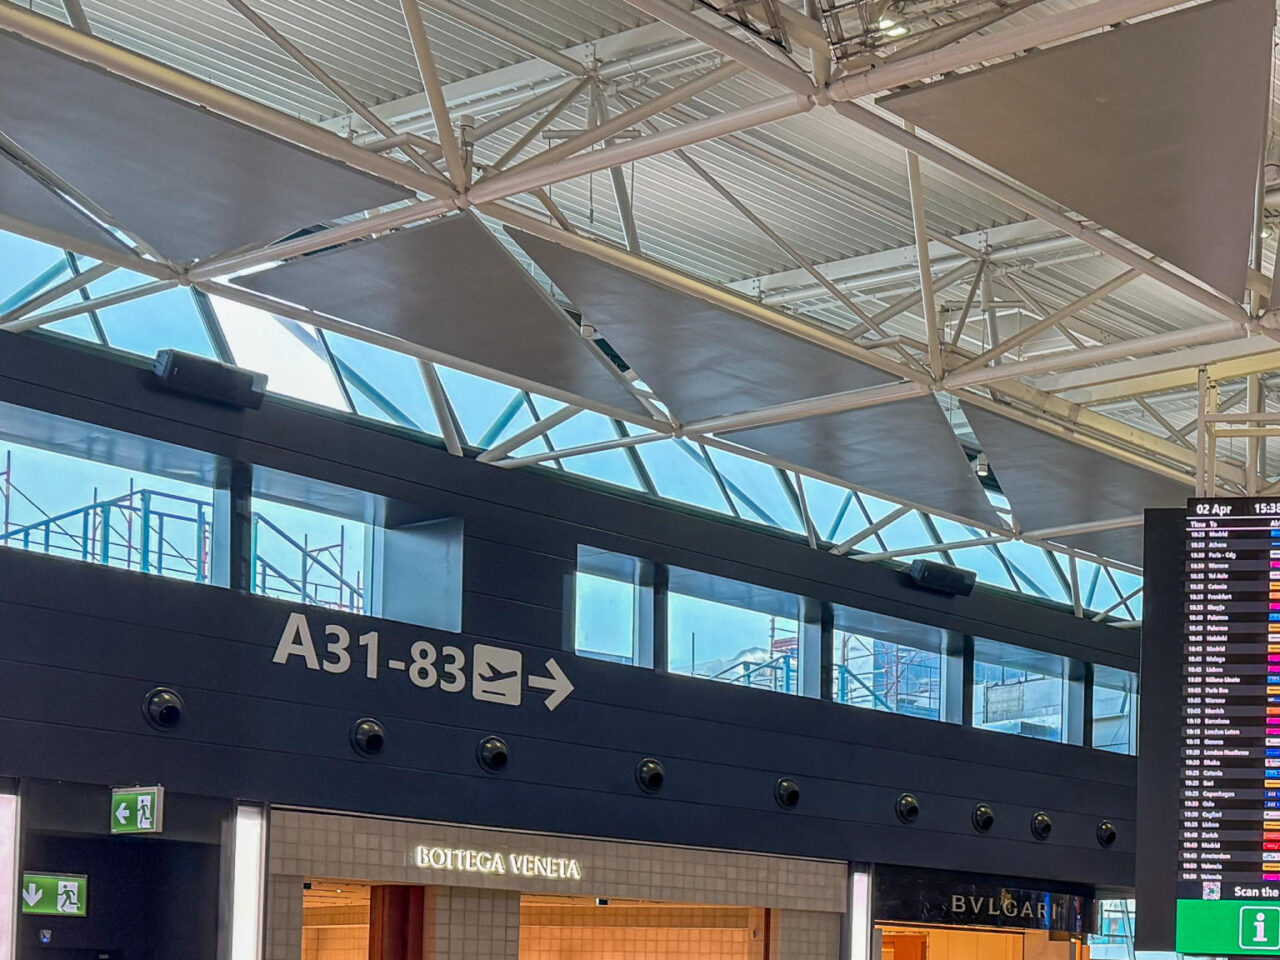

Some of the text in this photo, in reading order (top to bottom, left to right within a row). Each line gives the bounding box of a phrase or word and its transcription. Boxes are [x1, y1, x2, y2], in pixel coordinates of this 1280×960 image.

[1196, 504, 1209, 514] 02
[1212, 504, 1232, 516] Apr
[1209, 520, 1217, 528] To
[272, 612, 466, 693] A31-83
[416, 845, 582, 879] BOTTEGA VENETA
[1234, 886, 1259, 897] Scan
[1261, 886, 1279, 898] the
[951, 895, 1056, 920] BVLGARI
